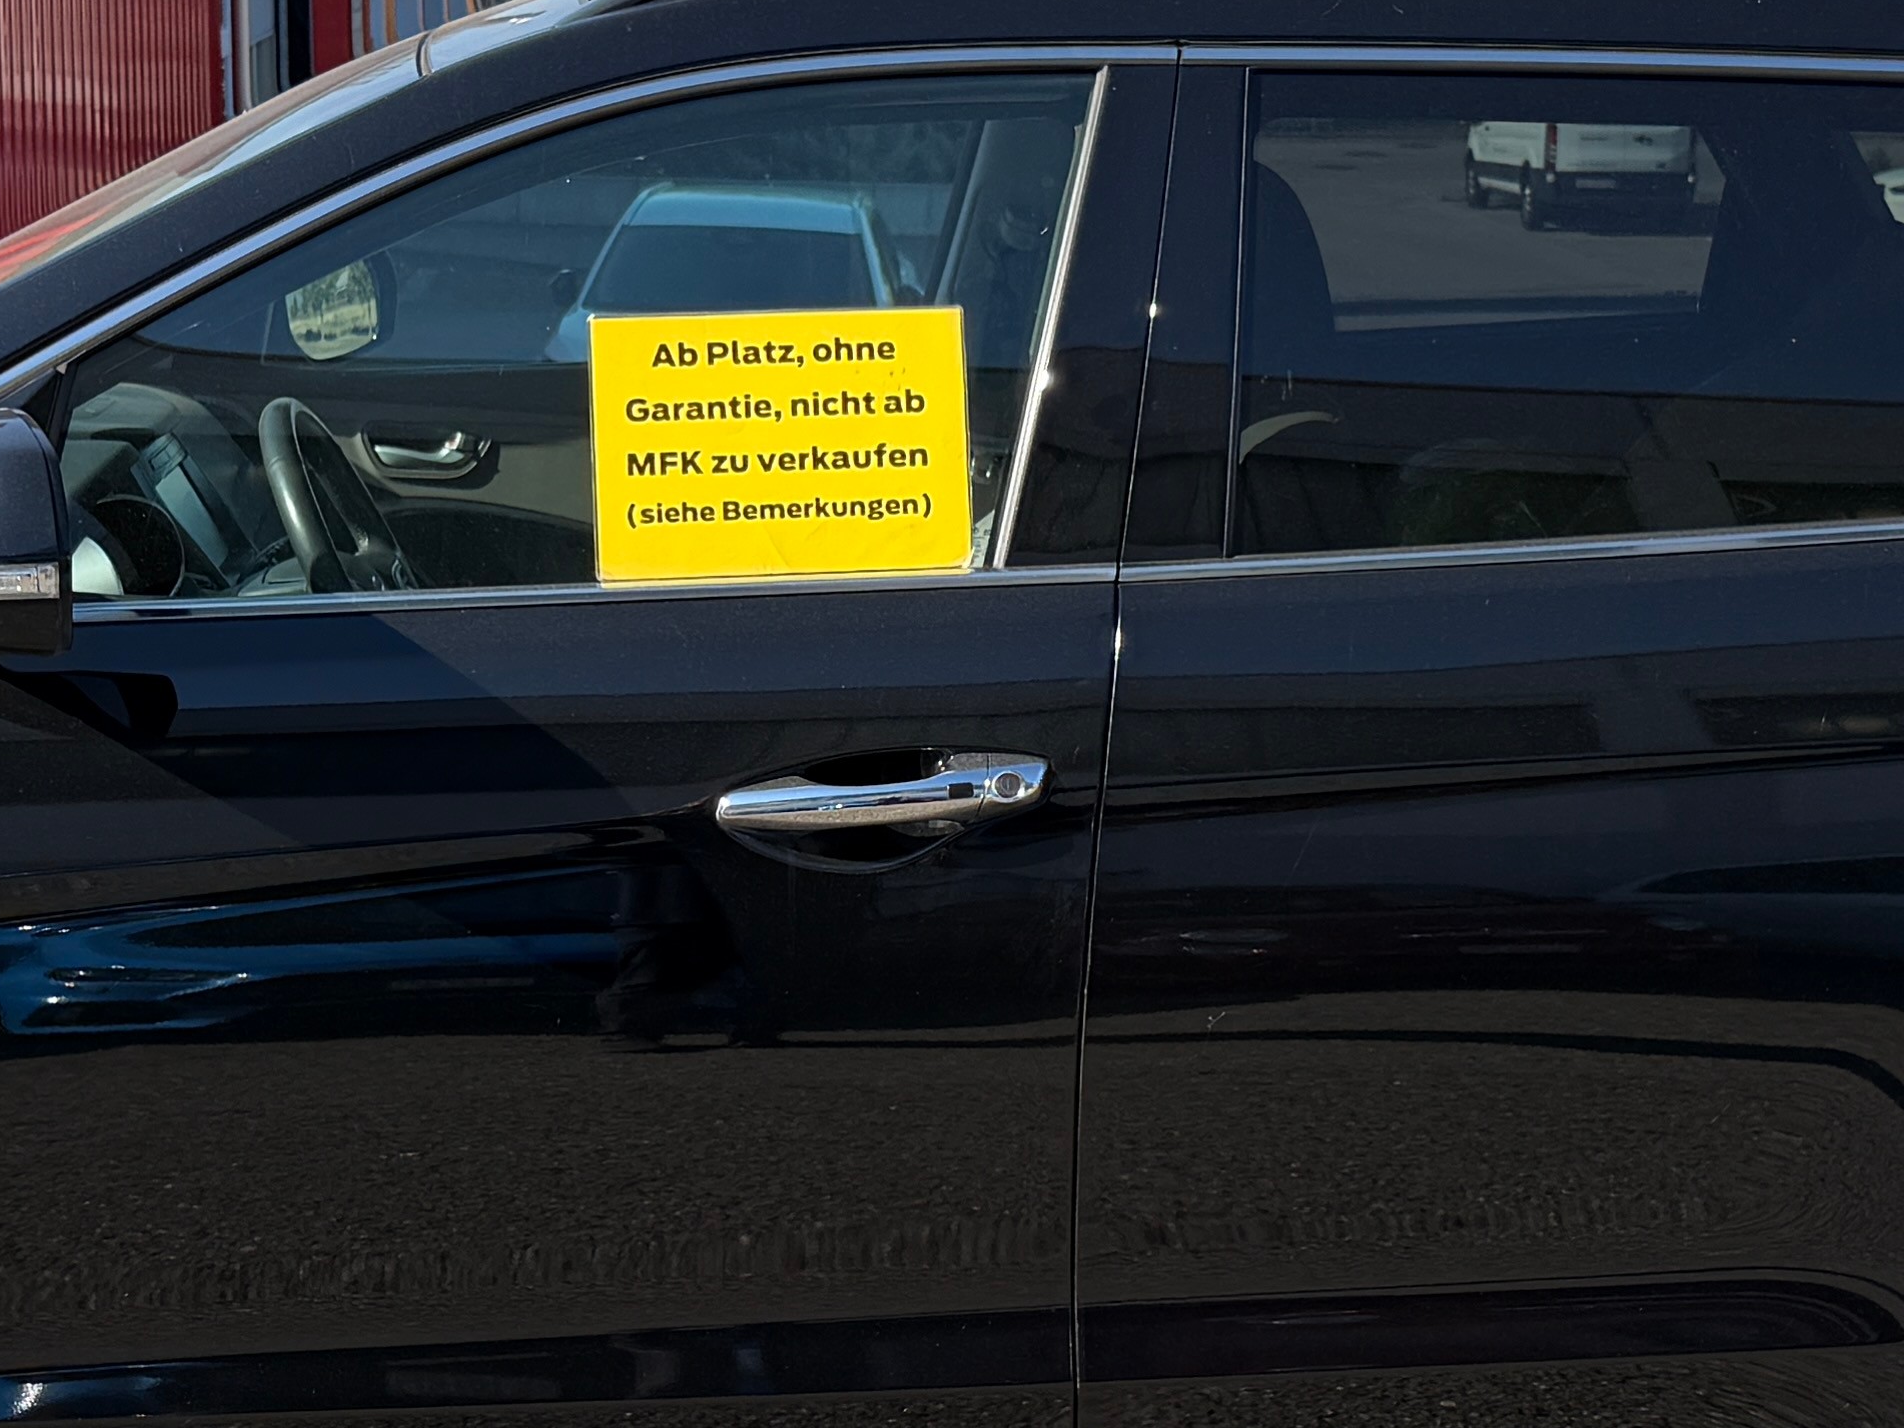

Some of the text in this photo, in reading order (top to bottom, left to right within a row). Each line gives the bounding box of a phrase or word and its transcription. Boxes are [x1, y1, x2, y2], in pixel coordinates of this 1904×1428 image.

[652, 337, 896, 368] Ab Platz, ohne
[625, 388, 925, 423] Garantie, nicht ab
[627, 442, 928, 476] MFK zu verkaufen
[627, 493, 932, 529] (siehe Bemerkungen)
